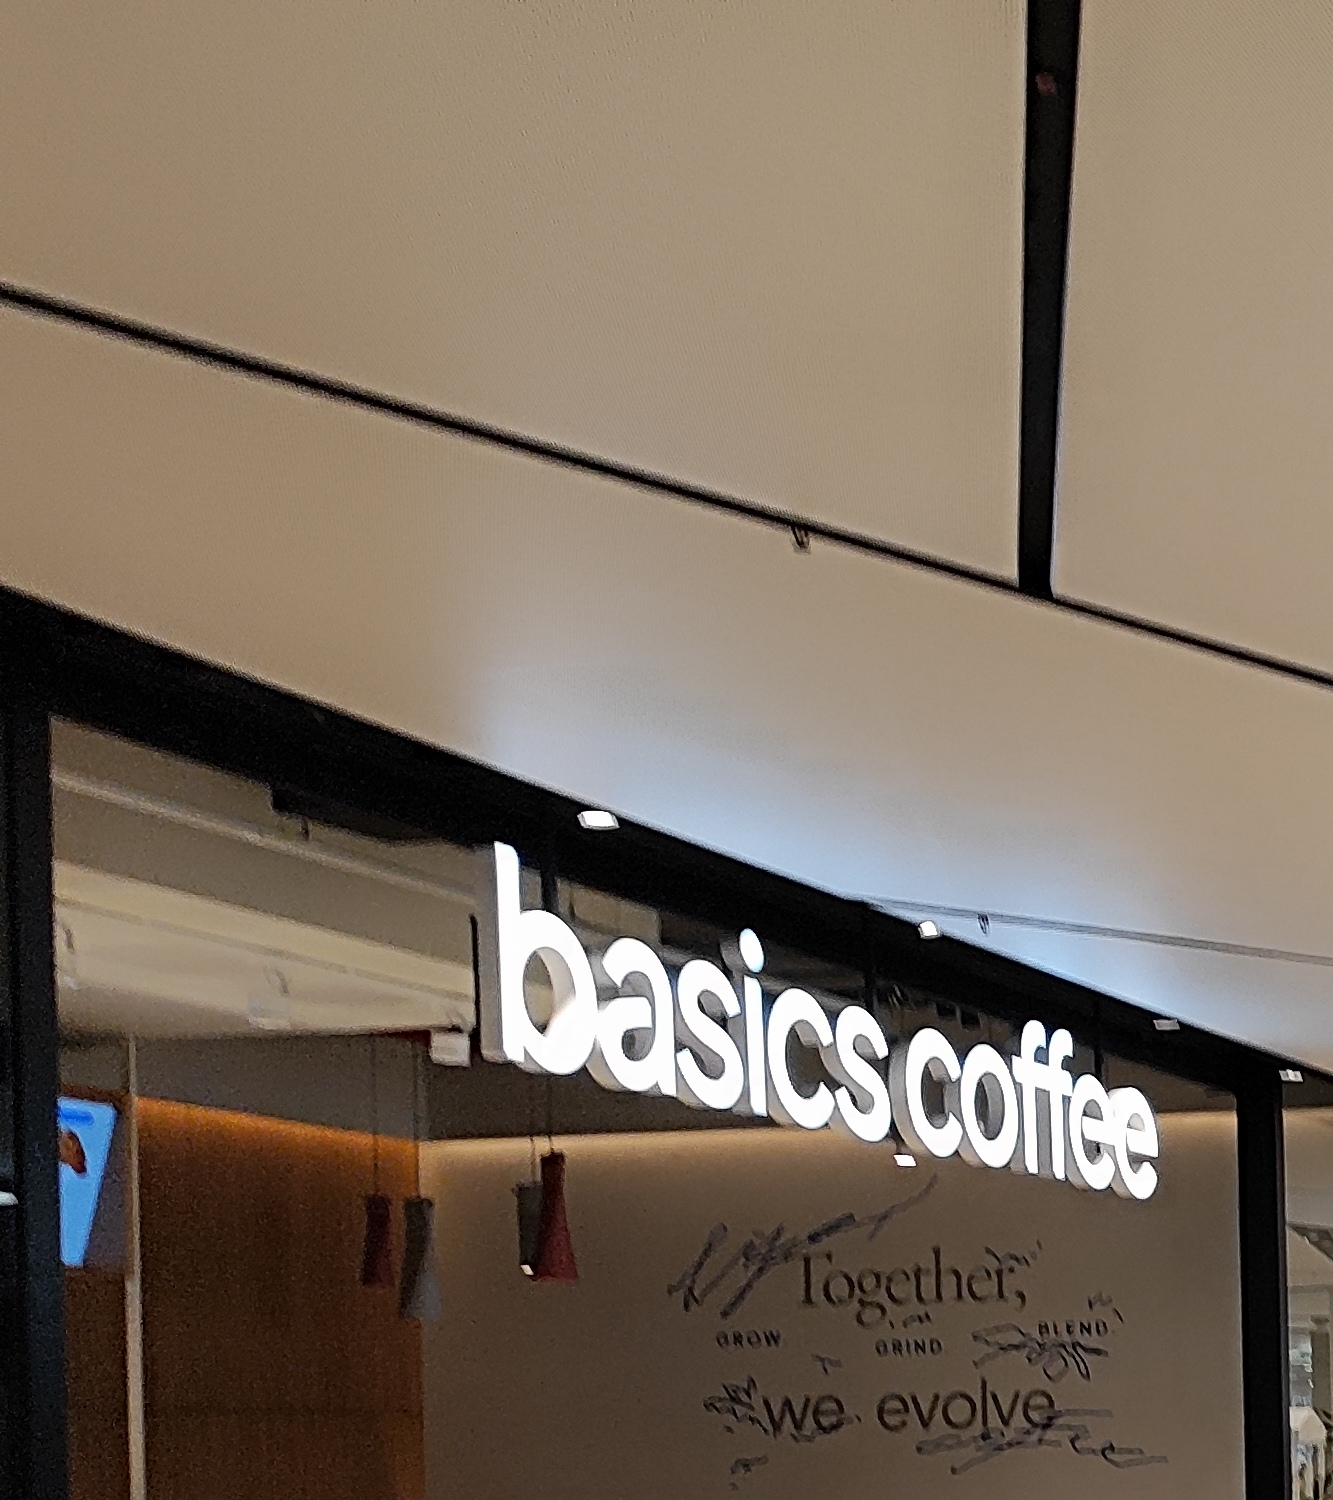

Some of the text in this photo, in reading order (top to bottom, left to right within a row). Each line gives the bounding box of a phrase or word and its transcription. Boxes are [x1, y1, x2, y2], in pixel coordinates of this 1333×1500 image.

[494, 841, 1160, 1200] basics coffee
[763, 1377, 1056, 1437] we evolve
